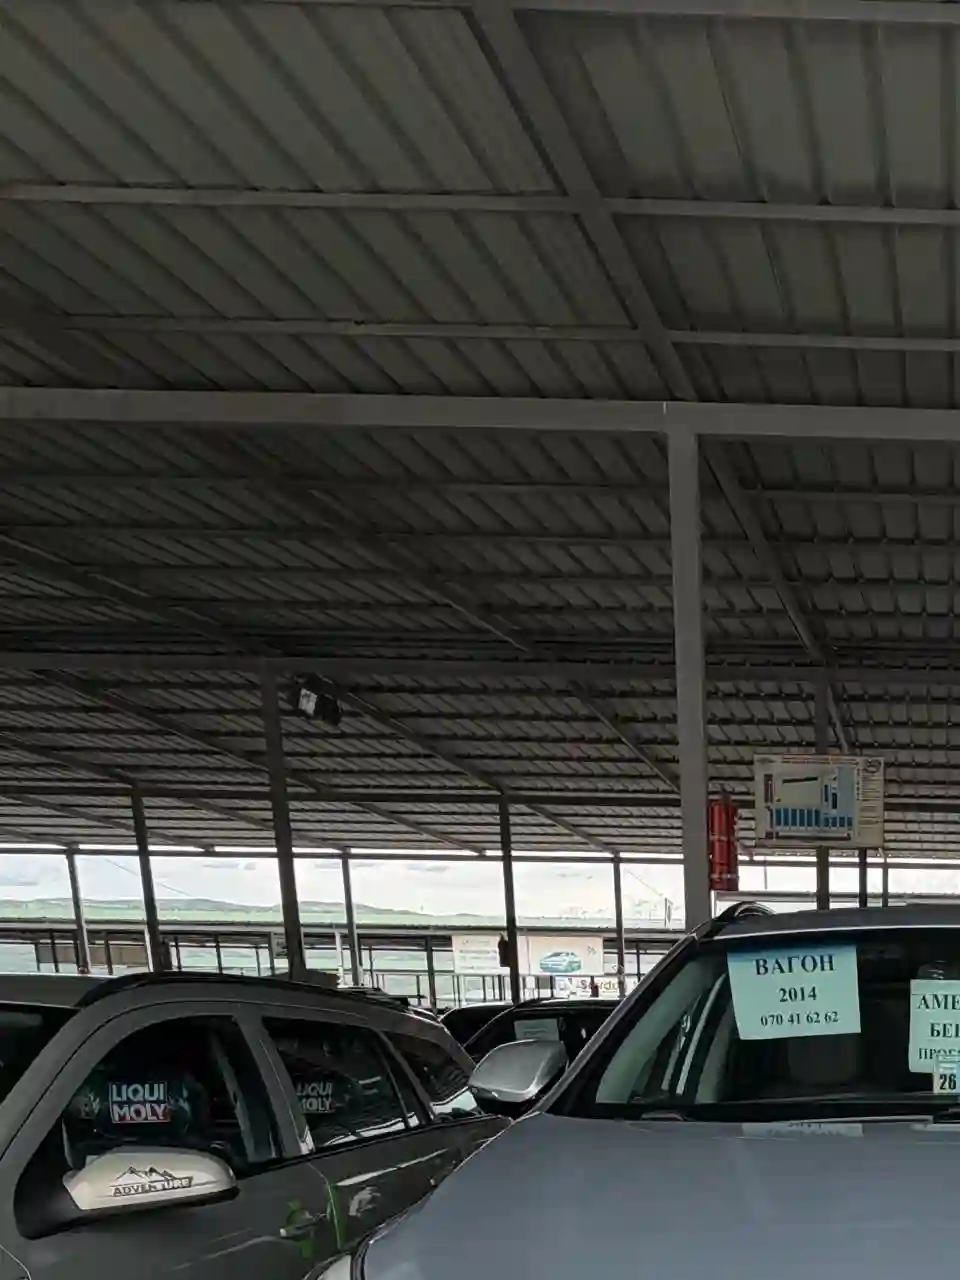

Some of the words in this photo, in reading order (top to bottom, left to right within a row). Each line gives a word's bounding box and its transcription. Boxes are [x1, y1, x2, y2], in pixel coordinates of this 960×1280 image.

[754, 954, 835, 976] ВАГОН
[779, 986, 817, 1003] 2014
[760, 1013, 783, 1027] 070
[787, 1012, 801, 1025] 41
[806, 1011, 821, 1024] 62
[824, 1010, 839, 1023] 62
[939, 1073, 957, 1090] 26
[111, 1083, 165, 1101] LIQUI
[113, 1103, 169, 1122] MOLY
